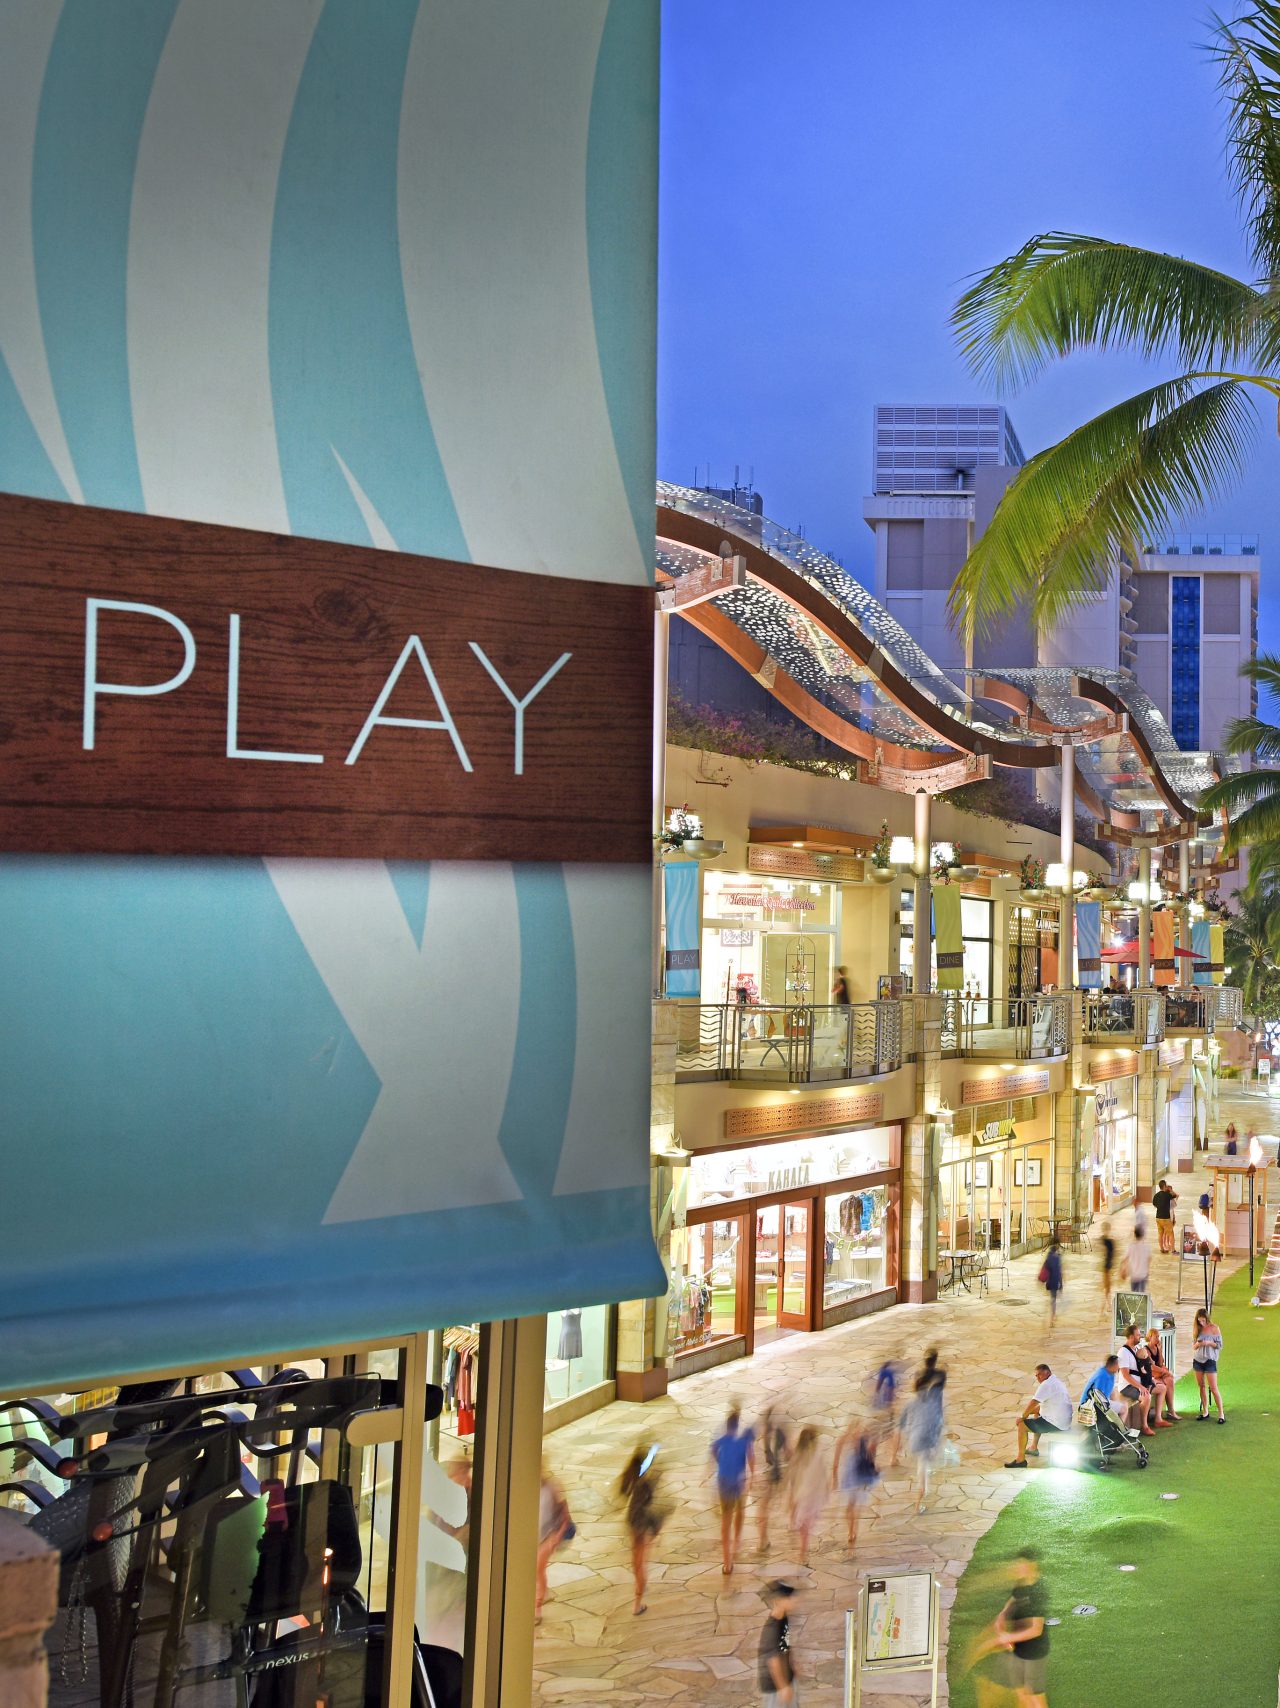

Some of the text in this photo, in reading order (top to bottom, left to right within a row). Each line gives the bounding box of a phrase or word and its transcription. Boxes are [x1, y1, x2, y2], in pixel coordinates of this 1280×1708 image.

[82, 597, 573, 776] PLAY
[671, 953, 696, 966] PLAY
[939, 955, 961, 965] DINE
[982, 1117, 1016, 1141] SUBWAY
[768, 1164, 809, 1191] KAHALA
